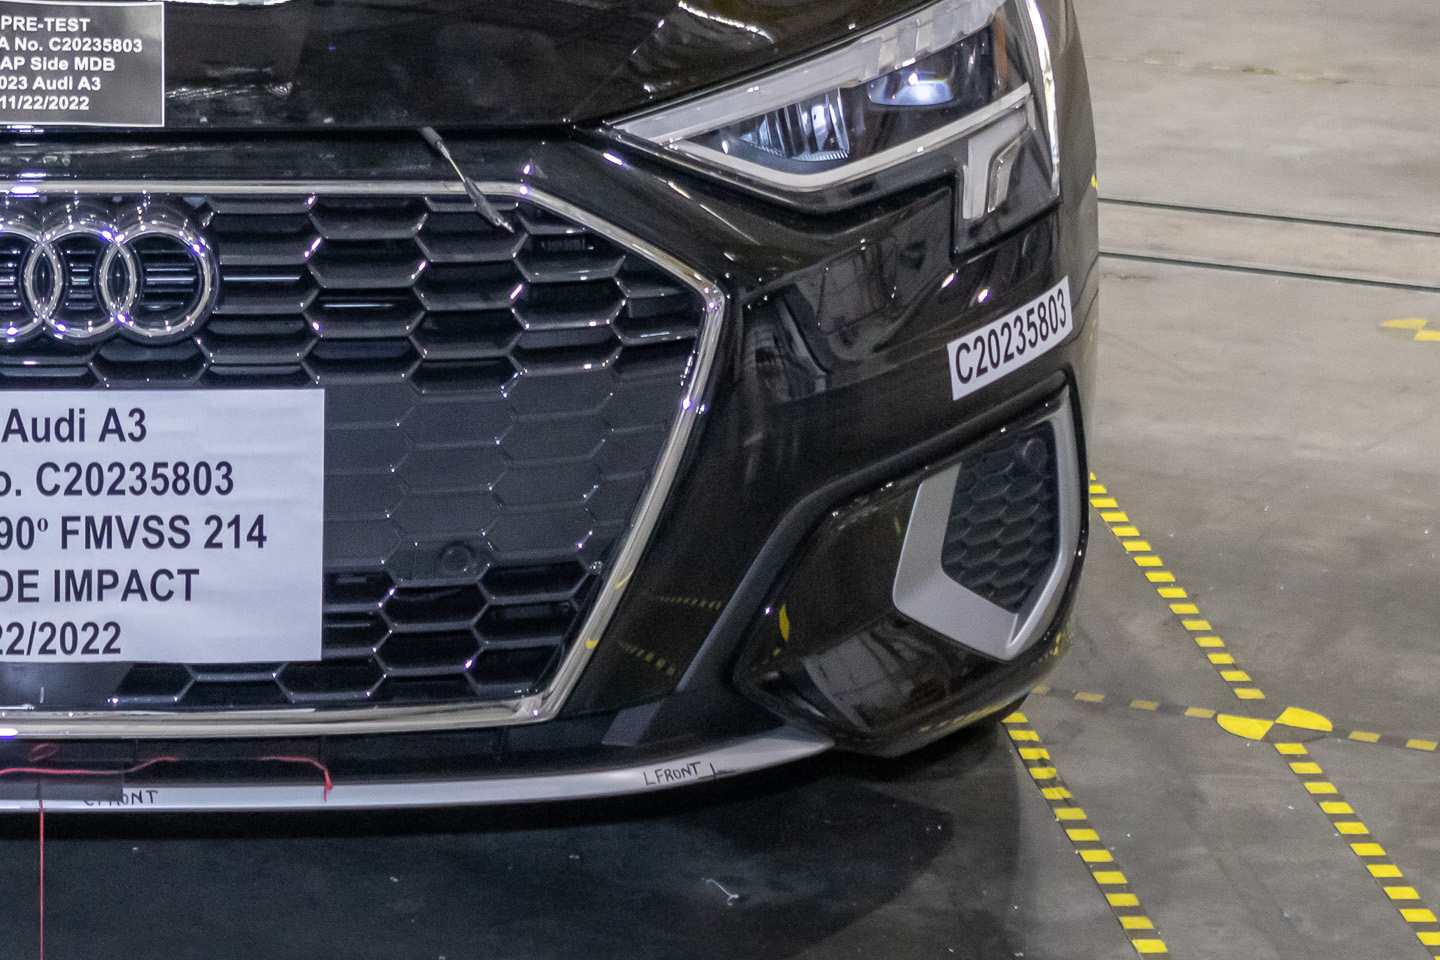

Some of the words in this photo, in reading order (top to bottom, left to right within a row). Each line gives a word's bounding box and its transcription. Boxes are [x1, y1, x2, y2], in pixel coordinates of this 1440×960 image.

[1, 16, 90, 32] PRE-TEST
[15, 37, 43, 51] No.
[49, 37, 142, 52] C20235803
[31, 57, 68, 70] Side
[75, 57, 115, 71] MDB
[33, 76, 72, 90] Audi
[78, 76, 101, 90] A3
[0, 95, 89, 110] 11/22/2022
[956, 288, 1066, 384] C20235803
[2, 408, 85, 442] Audi
[99, 408, 146, 442] A3
[36, 461, 233, 496] C20235803
[62, 515, 190, 549] FMVSS
[204, 515, 267, 548] 214
[55, 569, 199, 602] IMPACT
